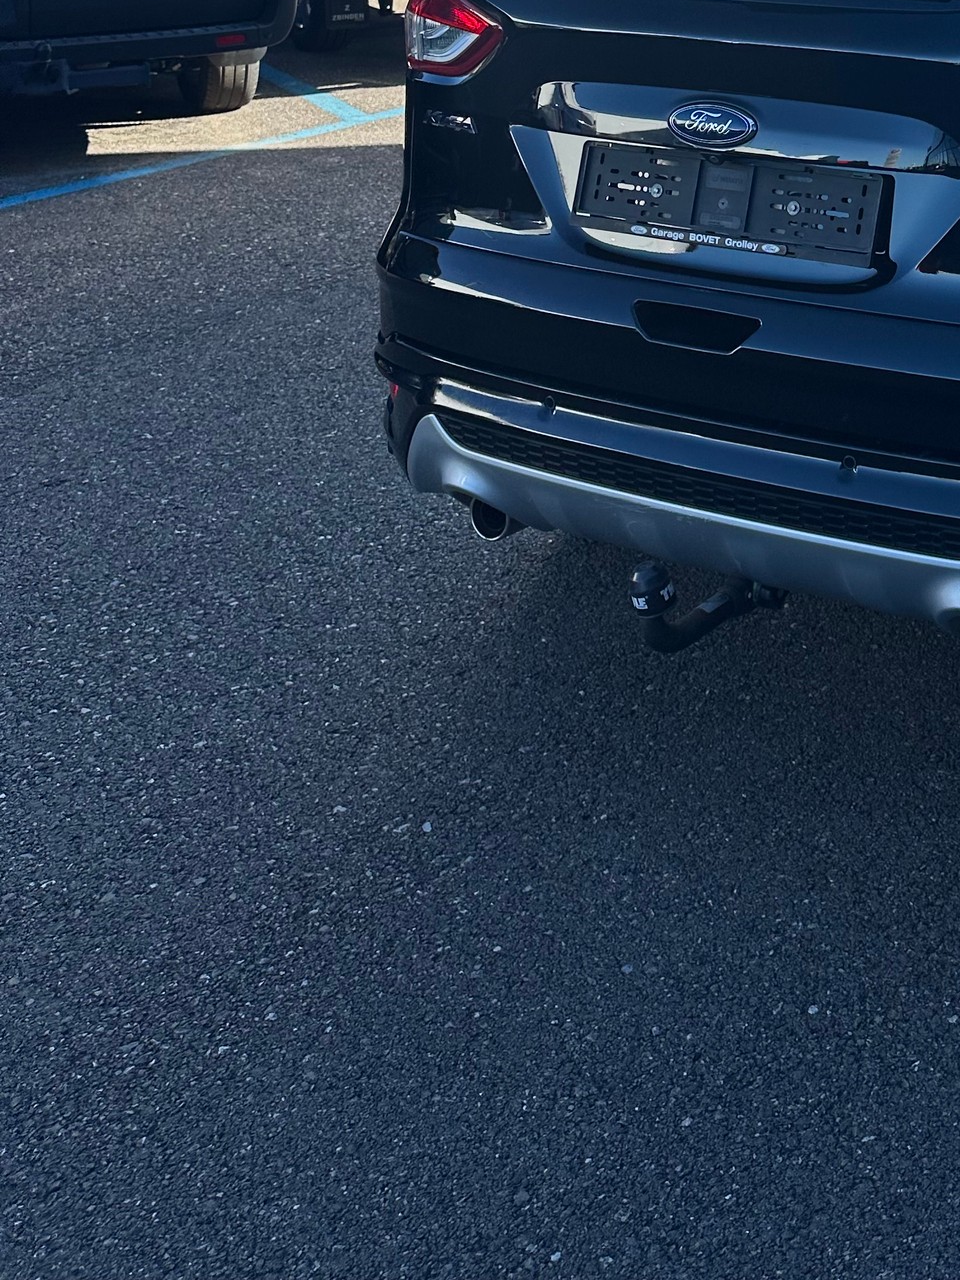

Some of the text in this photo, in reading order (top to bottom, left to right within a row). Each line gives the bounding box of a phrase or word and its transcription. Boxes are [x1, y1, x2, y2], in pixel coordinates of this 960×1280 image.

[684, 109, 733, 135] Ford
[650, 227, 685, 241] Garage
[689, 233, 721, 245] BOVET
[725, 237, 759, 252] Grolley
